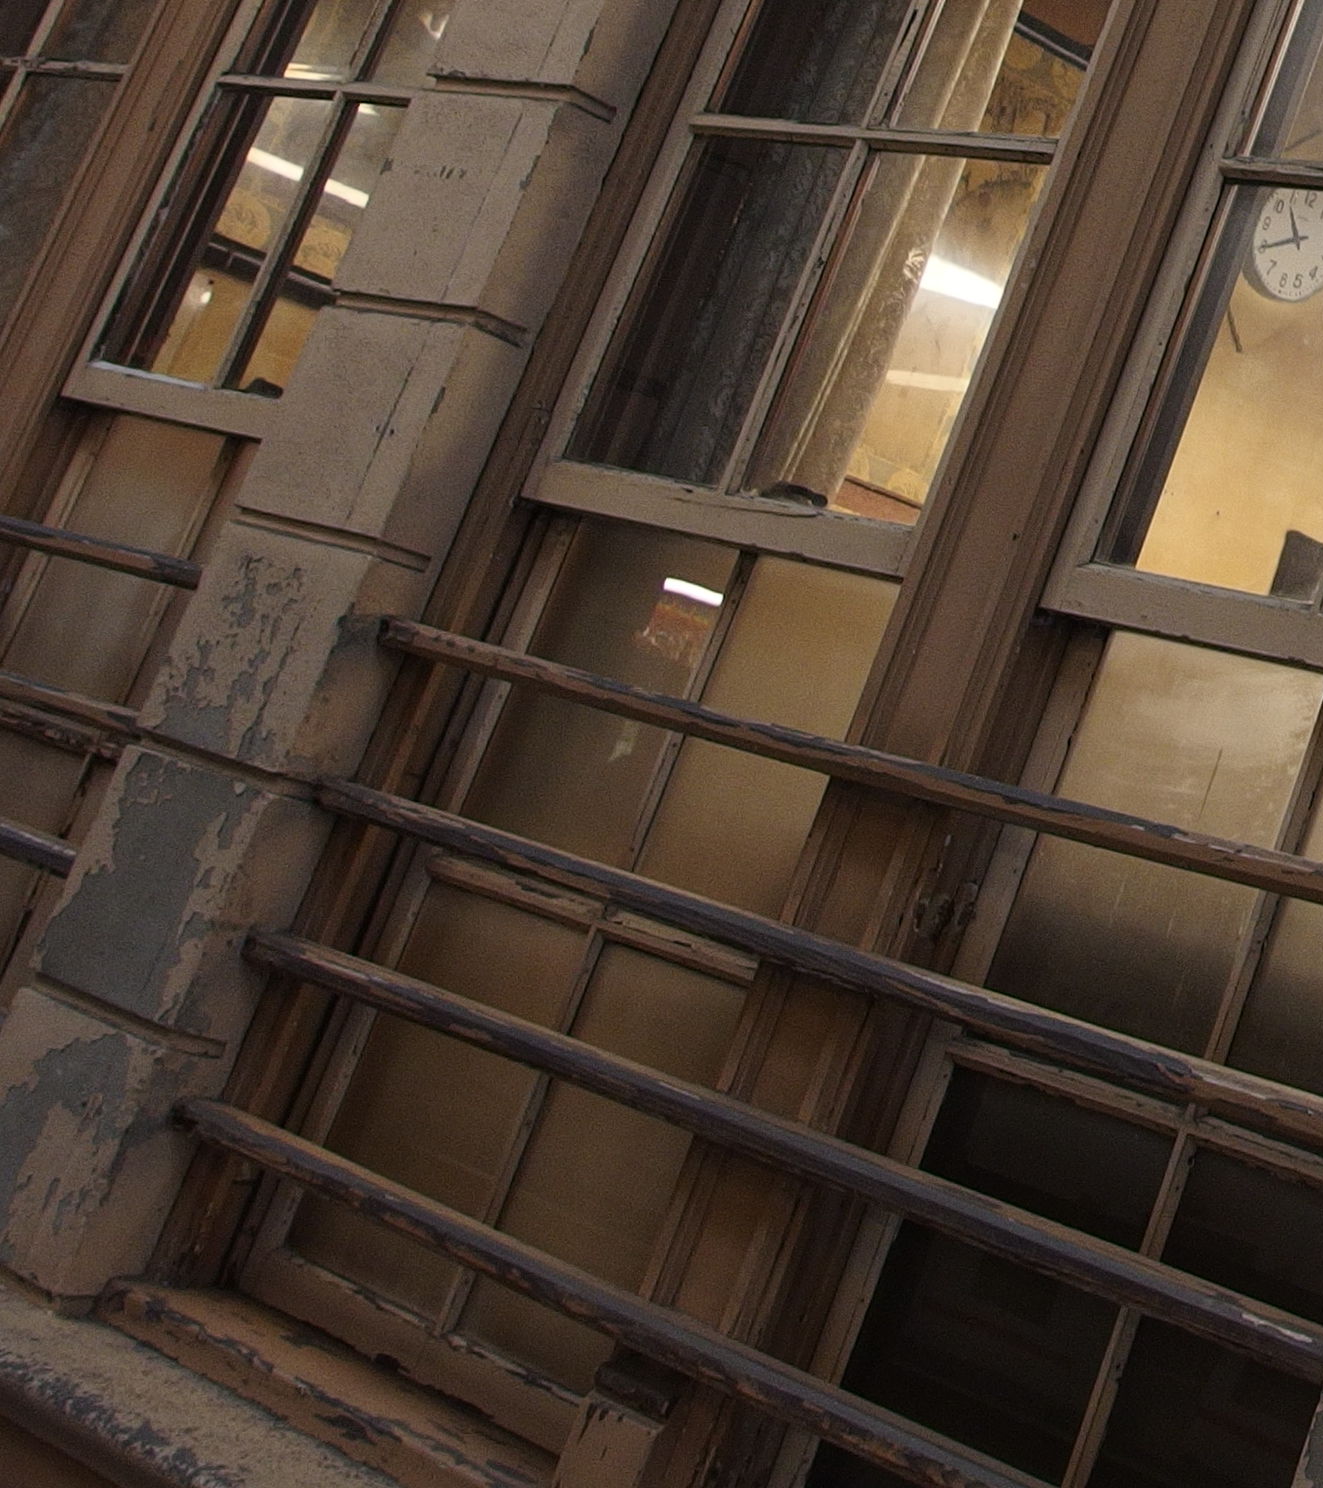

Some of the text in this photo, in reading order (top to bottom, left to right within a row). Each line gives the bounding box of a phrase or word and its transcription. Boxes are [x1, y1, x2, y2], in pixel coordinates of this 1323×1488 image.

[1266, 259, 1278, 276] 7
[1308, 265, 1319, 280] 4
[1279, 272, 1288, 288] 6
[1293, 273, 1304, 289] 5
